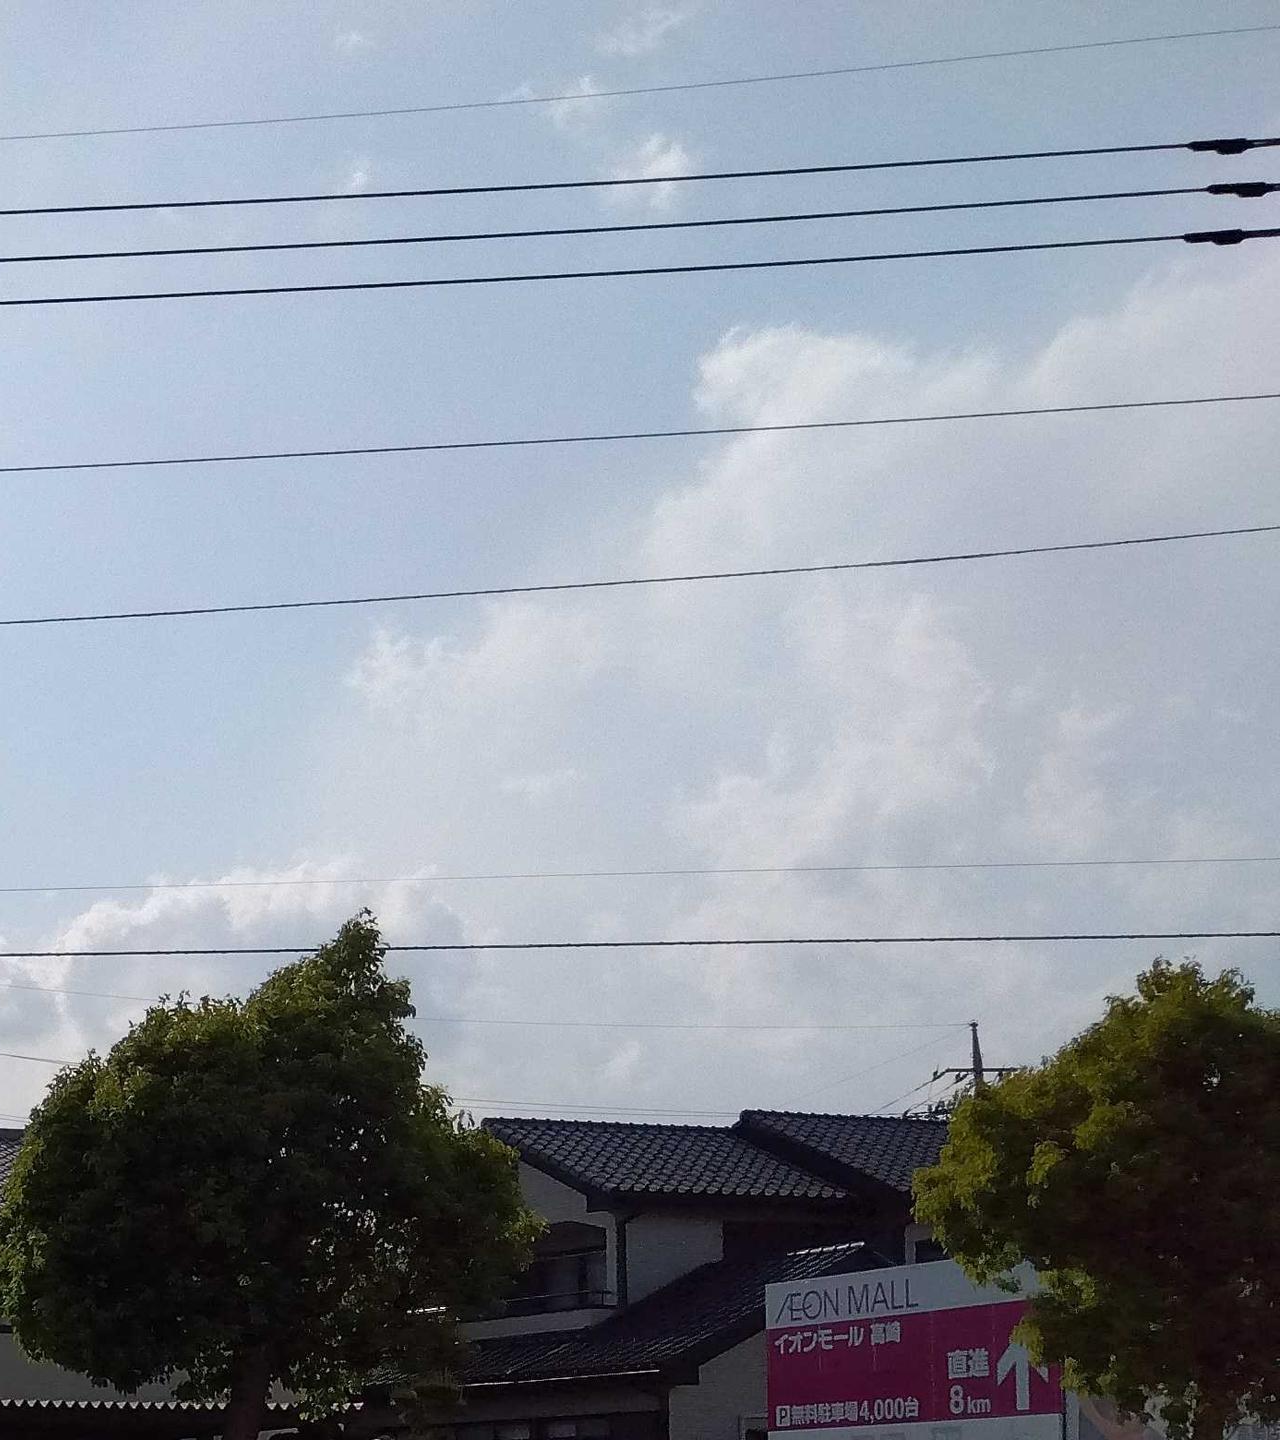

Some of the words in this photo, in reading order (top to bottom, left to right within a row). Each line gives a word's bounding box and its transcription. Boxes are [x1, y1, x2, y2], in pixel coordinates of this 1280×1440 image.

[848, 1279, 918, 1314] MALL
[775, 1326, 864, 1354] イオンモール
[947, 1348, 989, 1379] 直進
